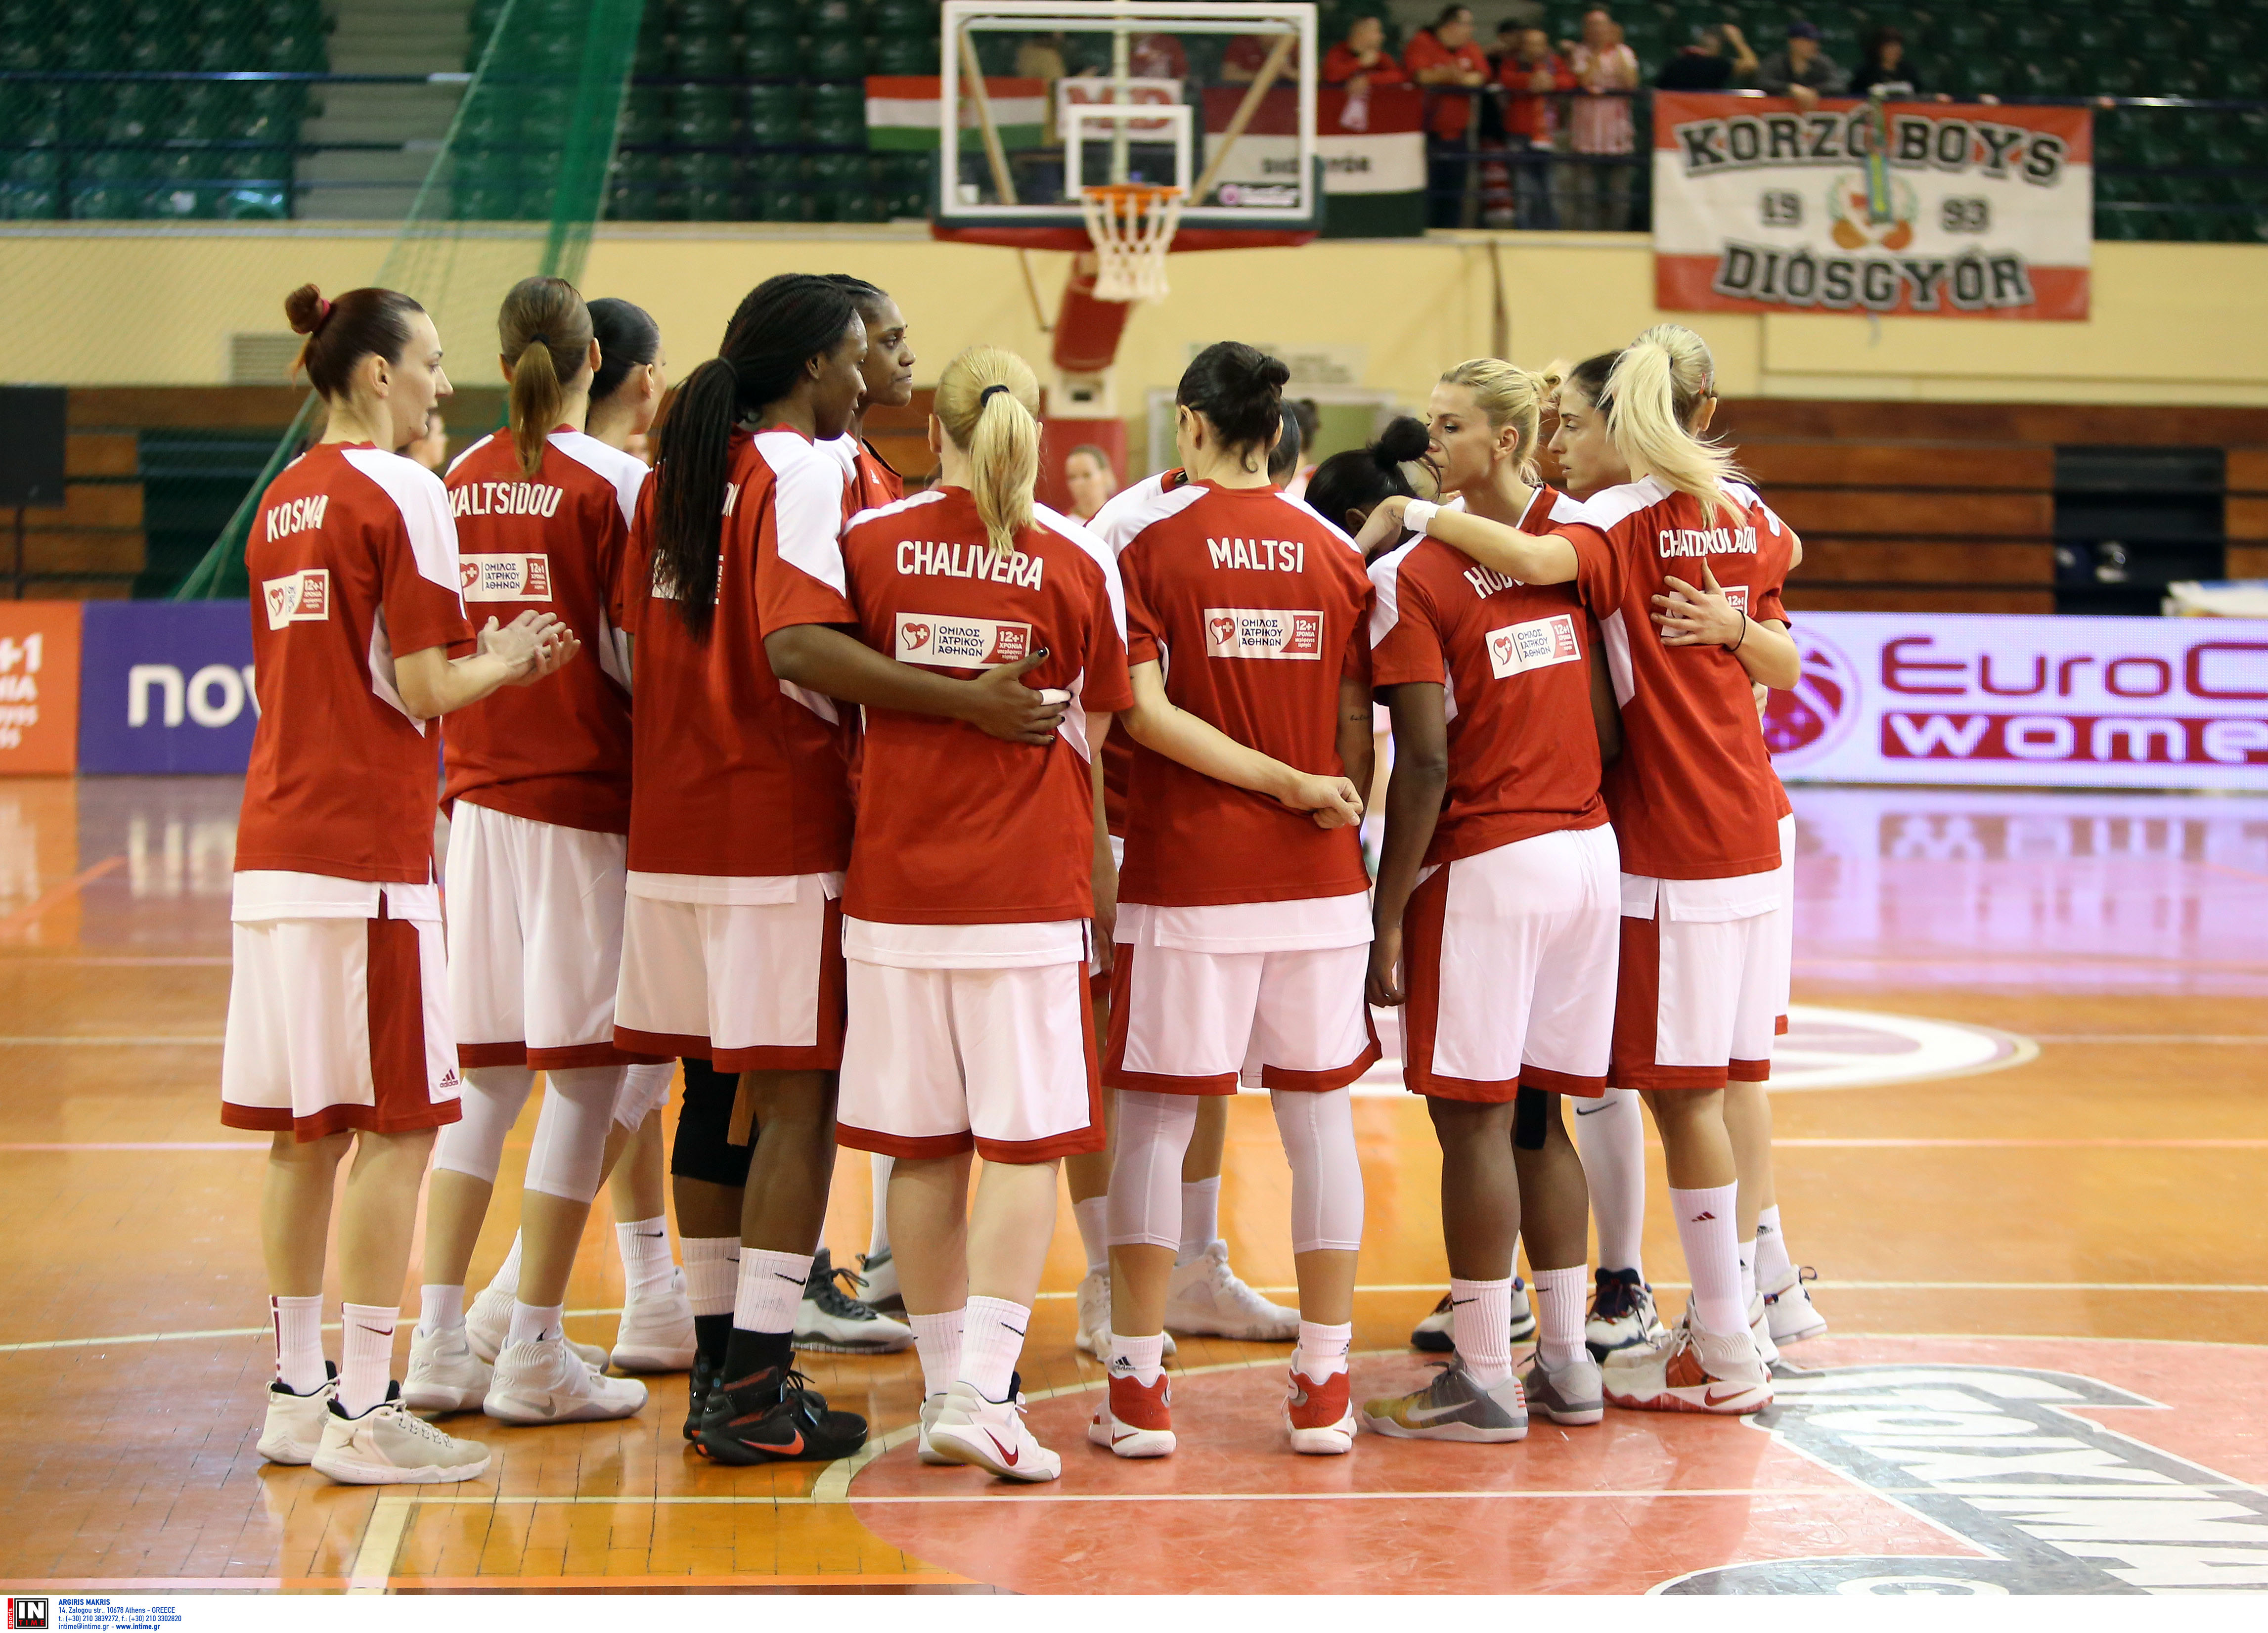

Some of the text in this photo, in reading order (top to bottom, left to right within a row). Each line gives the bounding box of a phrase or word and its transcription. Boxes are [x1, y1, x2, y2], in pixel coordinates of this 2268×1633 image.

[1900, 121, 2061, 177] BOYS
[1762, 193, 1988, 230] 19 93
[267, 494, 329, 543] KOSMA
[1206, 536, 1304, 574] MALTSI
[896, 540, 1044, 591] CHALIVERA
[485, 572, 519, 580] ΙΑΤΡΙΚΟΥ
[485, 581, 520, 589] ΑΘΗΝΩΝ
[1728, 595, 1744, 606] 12+1
[1242, 619, 1278, 627] ΟΜΙΛΟΣ
[1295, 619, 1316, 631] 12+1
[939, 625, 980, 637] ΟΜΙΛΟΣ
[999, 631, 1024, 643] 12+1
[1242, 628, 1283, 637] ΙΑΤΡΙΚΟΥ
[1517, 628, 1543, 640] ΟΜΙΛΟΣ
[939, 636, 985, 648] ΙΑΤΡΙΚΟΥ
[1242, 638, 1282, 647] ΑΘΗΝΩΝ
[1520, 636, 1549, 650] ΙΑΤΡΙΚΟΥ
[937, 646, 983, 658] ΑΘΗΝΩΝ
[1523, 647, 1552, 659] ΑΘΗΝΩΝ
